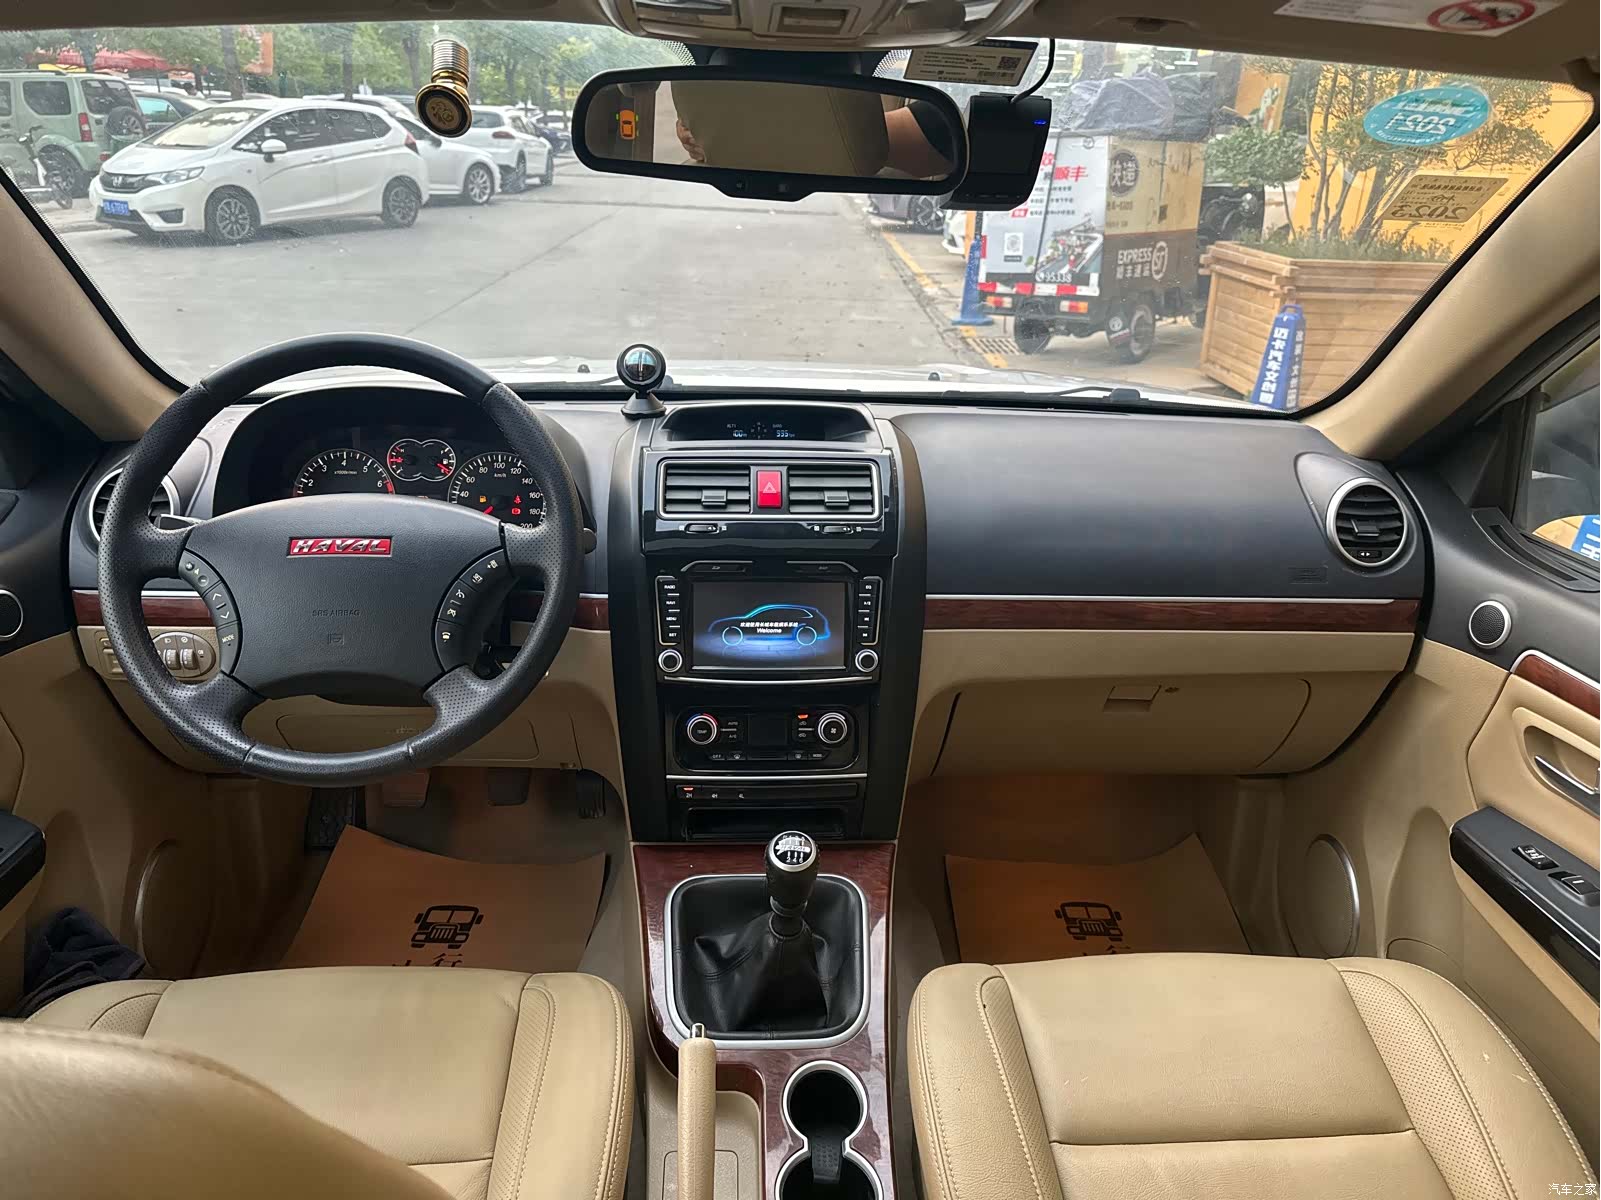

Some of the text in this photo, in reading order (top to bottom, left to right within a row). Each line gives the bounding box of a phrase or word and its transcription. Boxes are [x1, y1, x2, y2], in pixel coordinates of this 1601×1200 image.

[1117, 248, 1152, 265] EXPRESS
[1258, 326, 1290, 405] 迈卡汽车文创园
[479, 466, 488, 474] 80
[510, 467, 522, 475] 120
[307, 479, 314, 487] 2
[377, 480, 383, 488] 6
[466, 476, 476, 484] 60
[528, 507, 541, 515] 180
[292, 540, 387, 553] HAVAL
[311, 609, 361, 617] SRS AIRBAG
